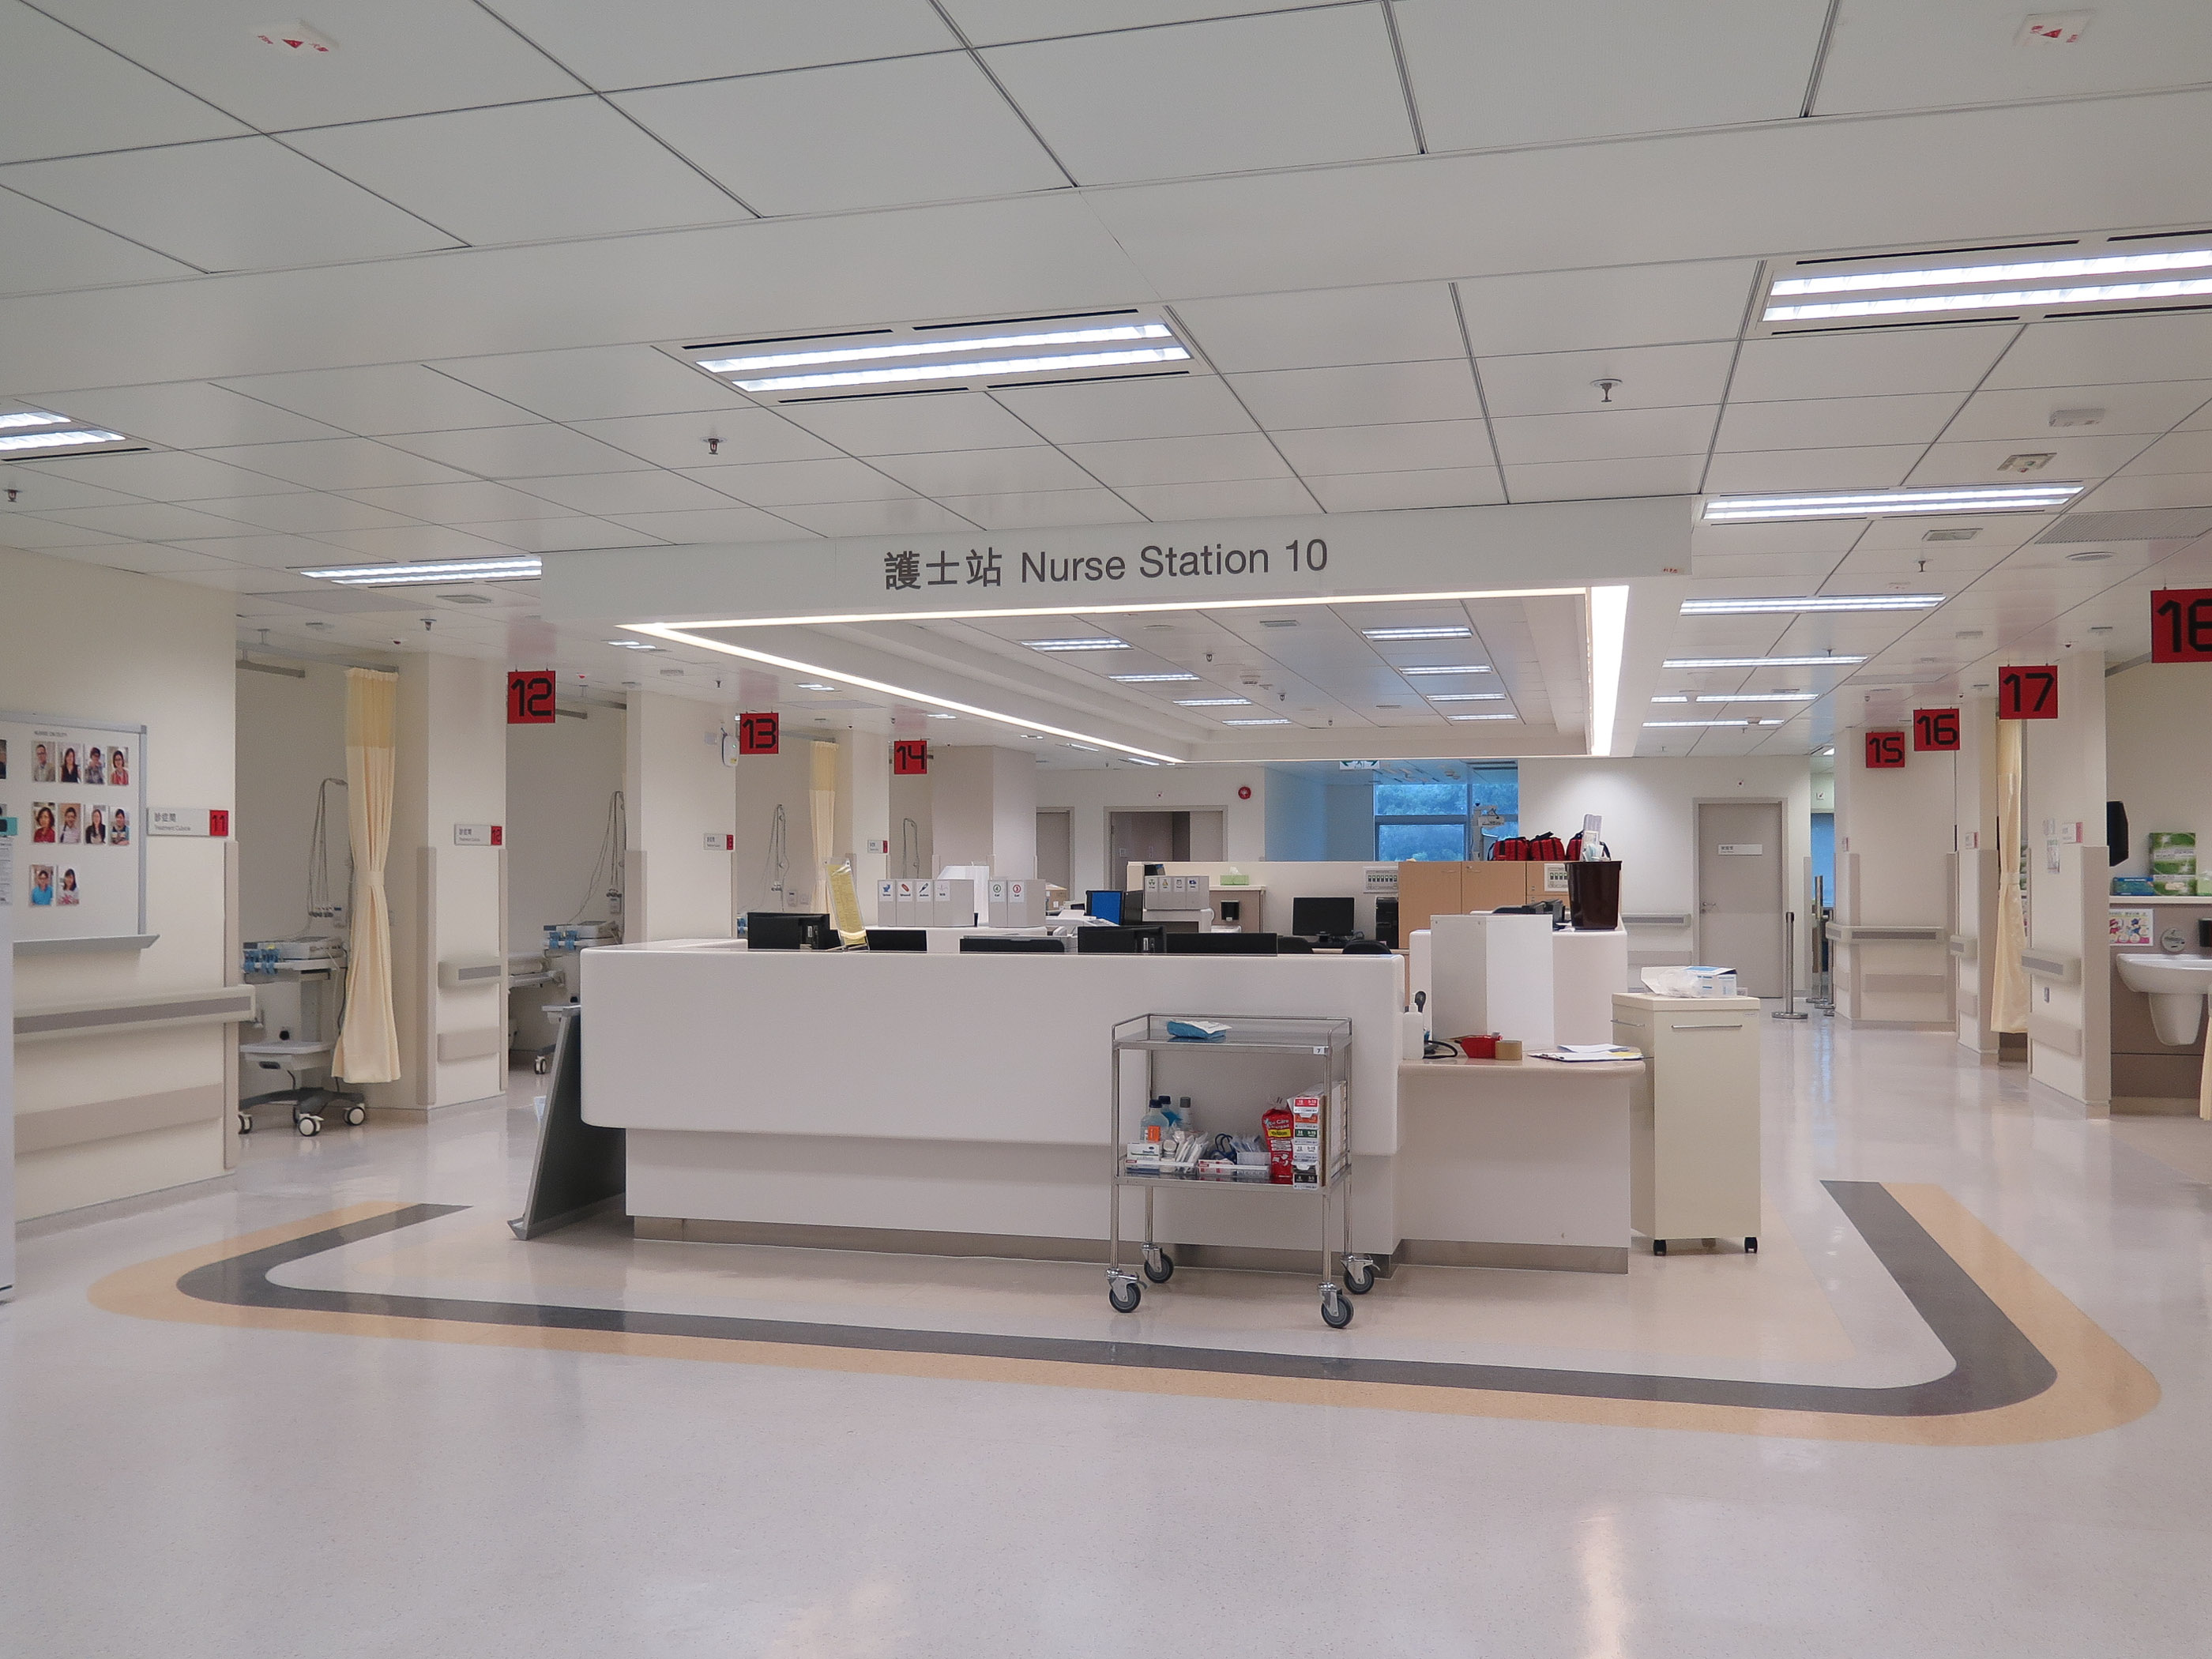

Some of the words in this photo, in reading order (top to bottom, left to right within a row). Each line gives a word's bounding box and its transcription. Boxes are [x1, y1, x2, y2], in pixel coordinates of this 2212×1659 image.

[884, 547, 1002, 590] 護士站
[1021, 551, 1126, 583] Nurse
[1140, 544, 1269, 577] Station
[1285, 539, 1328, 571] 10
[511, 678, 552, 717] 12
[2003, 672, 2055, 712] 17
[743, 718, 777, 749] 13
[1917, 714, 1958, 745] 16
[896, 745, 925, 770] 14
[1869, 737, 1903, 763] 15
[213, 814, 225, 832] 11
